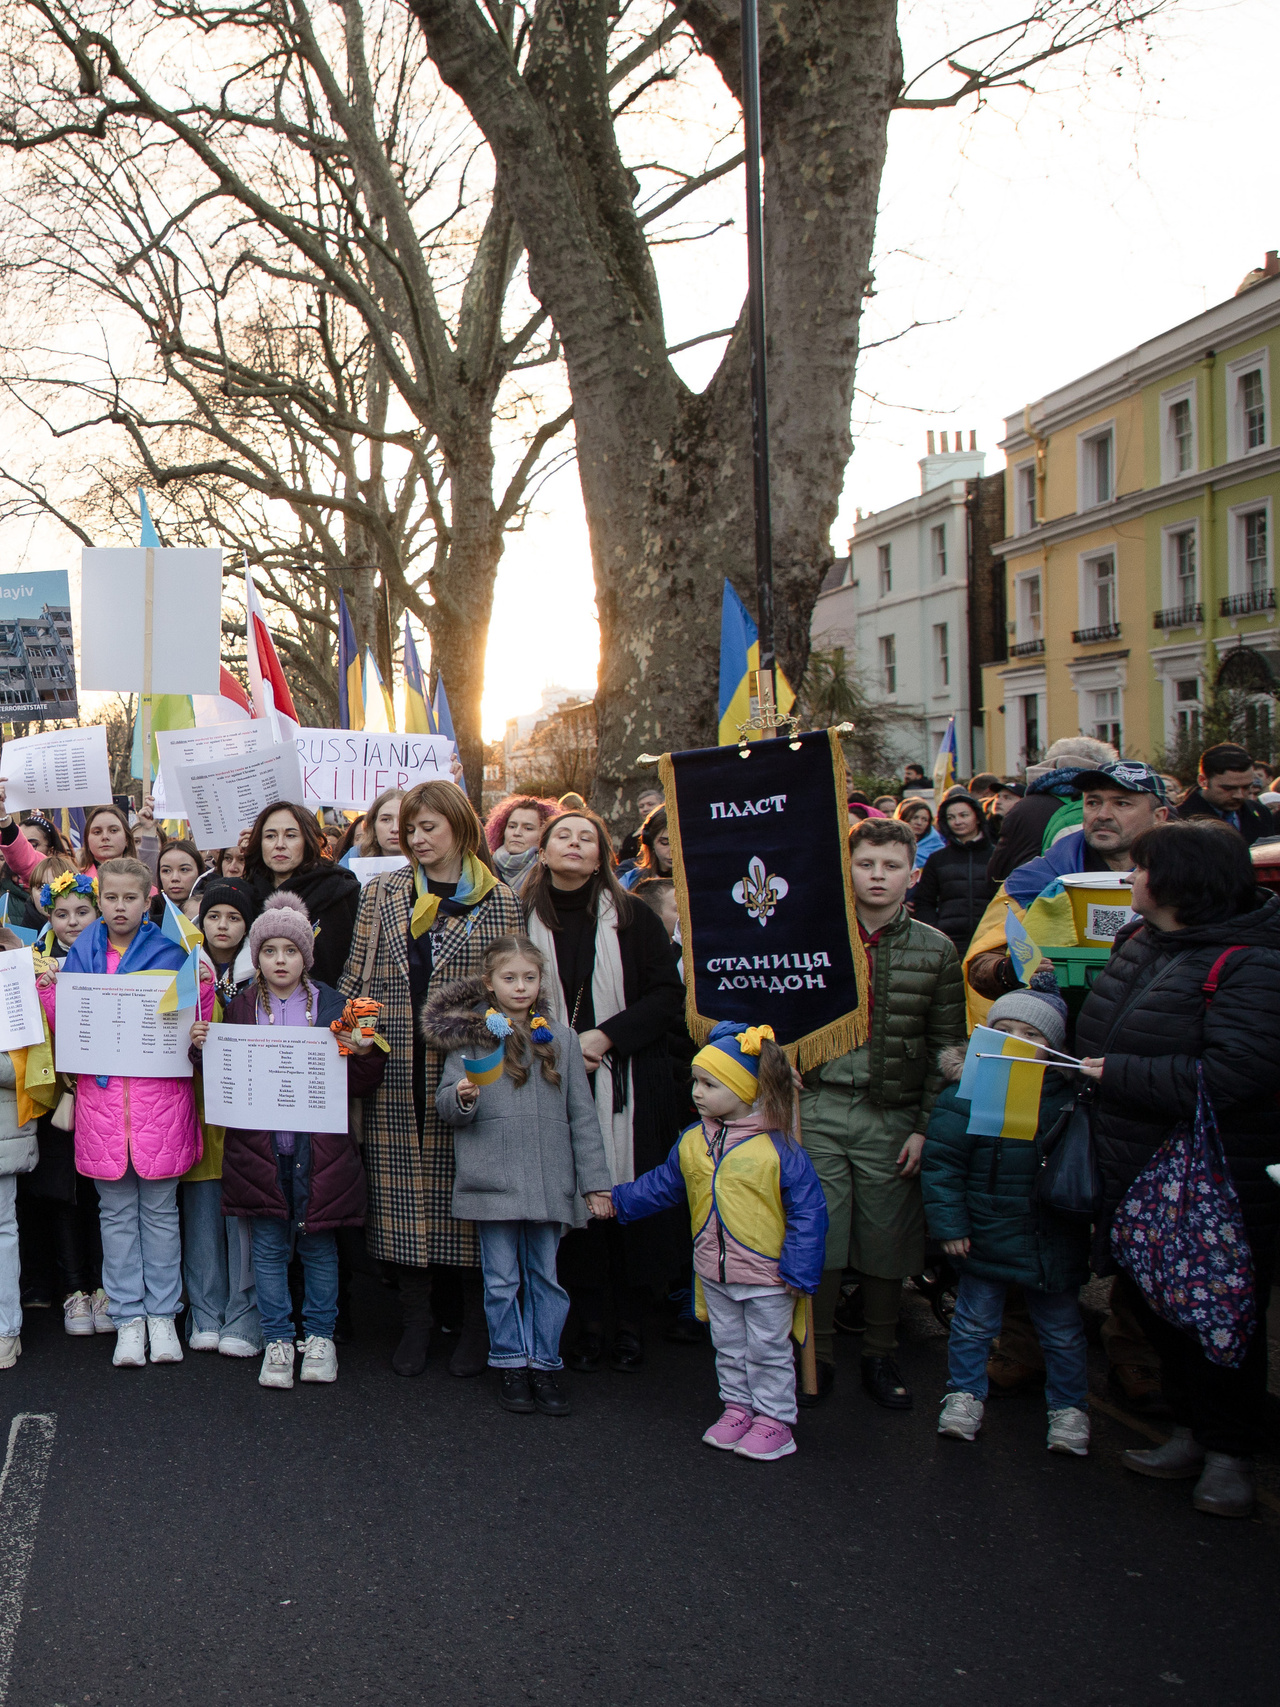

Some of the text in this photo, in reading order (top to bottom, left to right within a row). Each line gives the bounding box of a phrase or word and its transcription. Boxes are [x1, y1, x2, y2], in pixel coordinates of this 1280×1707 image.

[710, 794, 787, 820] ПЛАСТ
[706, 952, 832, 972] СТАНИЦЯ
[718, 974, 827, 994] ЛОНДОН
